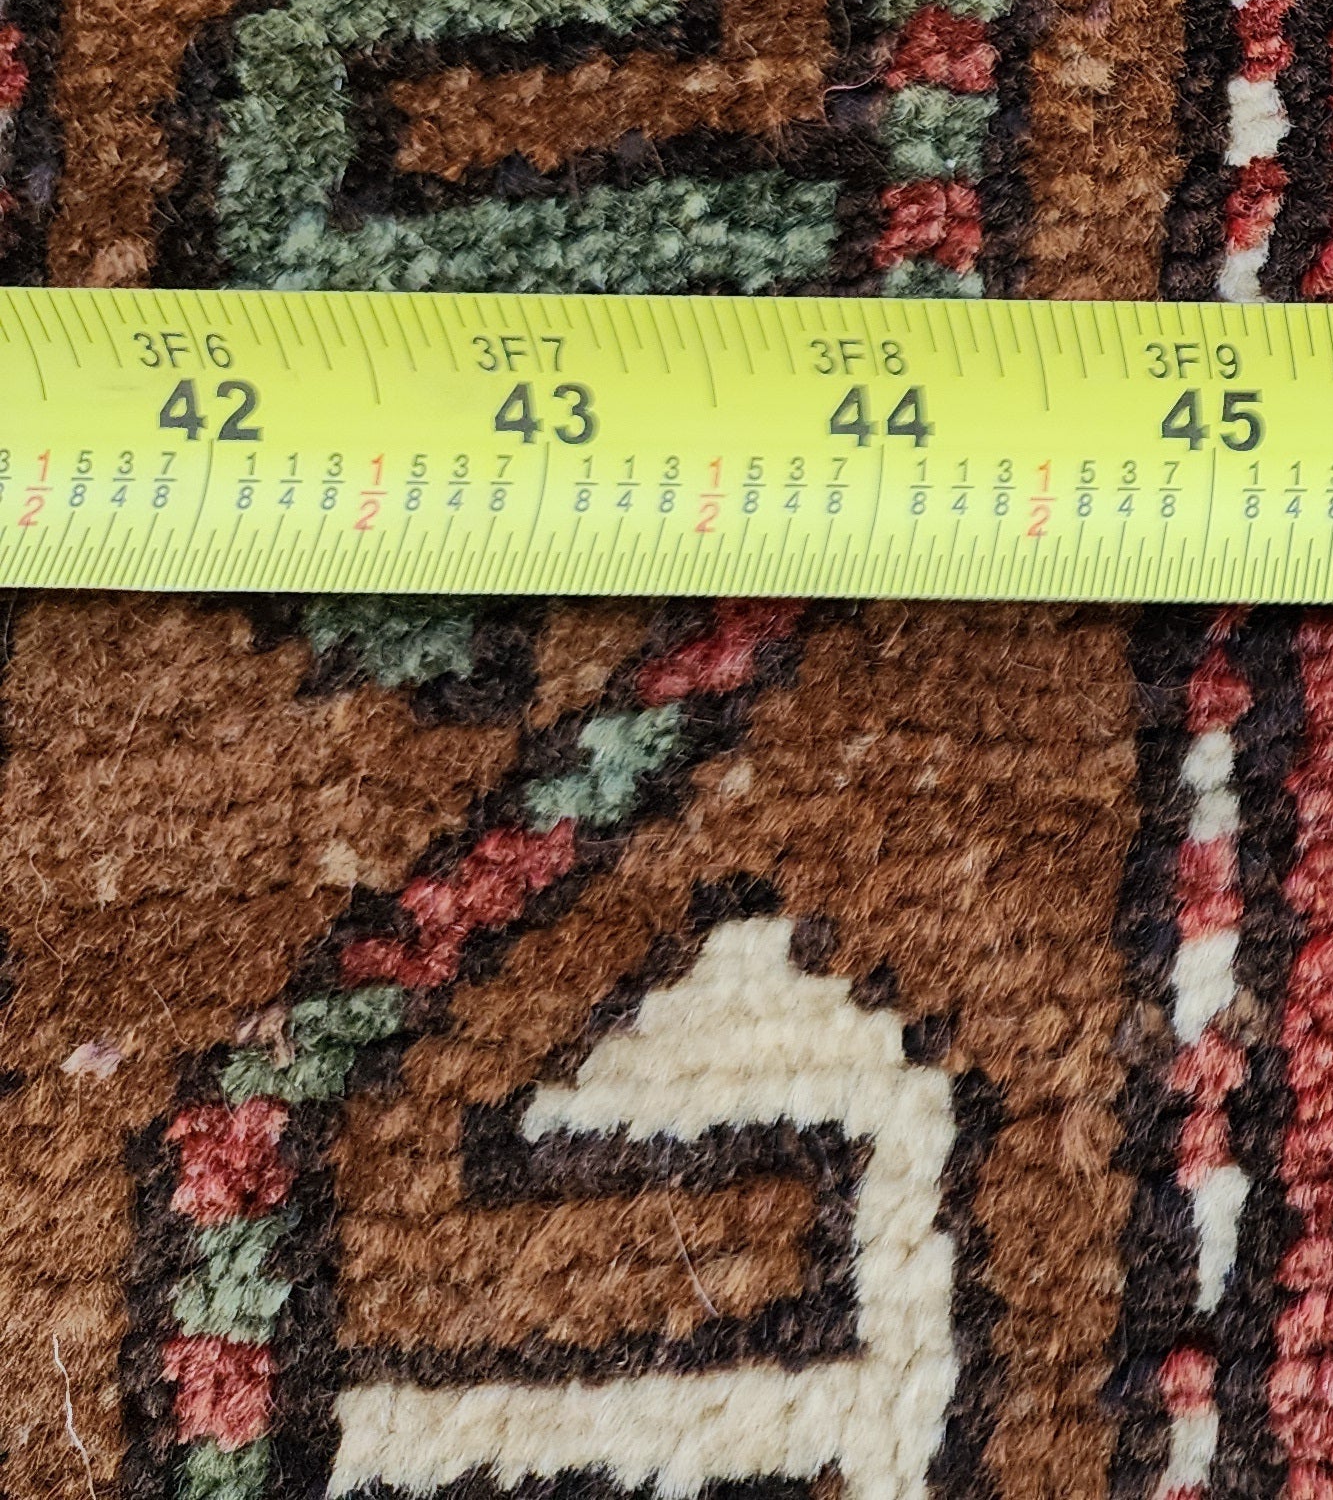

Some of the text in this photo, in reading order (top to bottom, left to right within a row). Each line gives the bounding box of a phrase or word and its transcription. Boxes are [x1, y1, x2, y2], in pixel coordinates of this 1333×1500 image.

[159, 378, 262, 441] 42
[494, 382, 597, 445] 43
[829, 385, 934, 448] 44
[1161, 388, 1264, 451] 45
